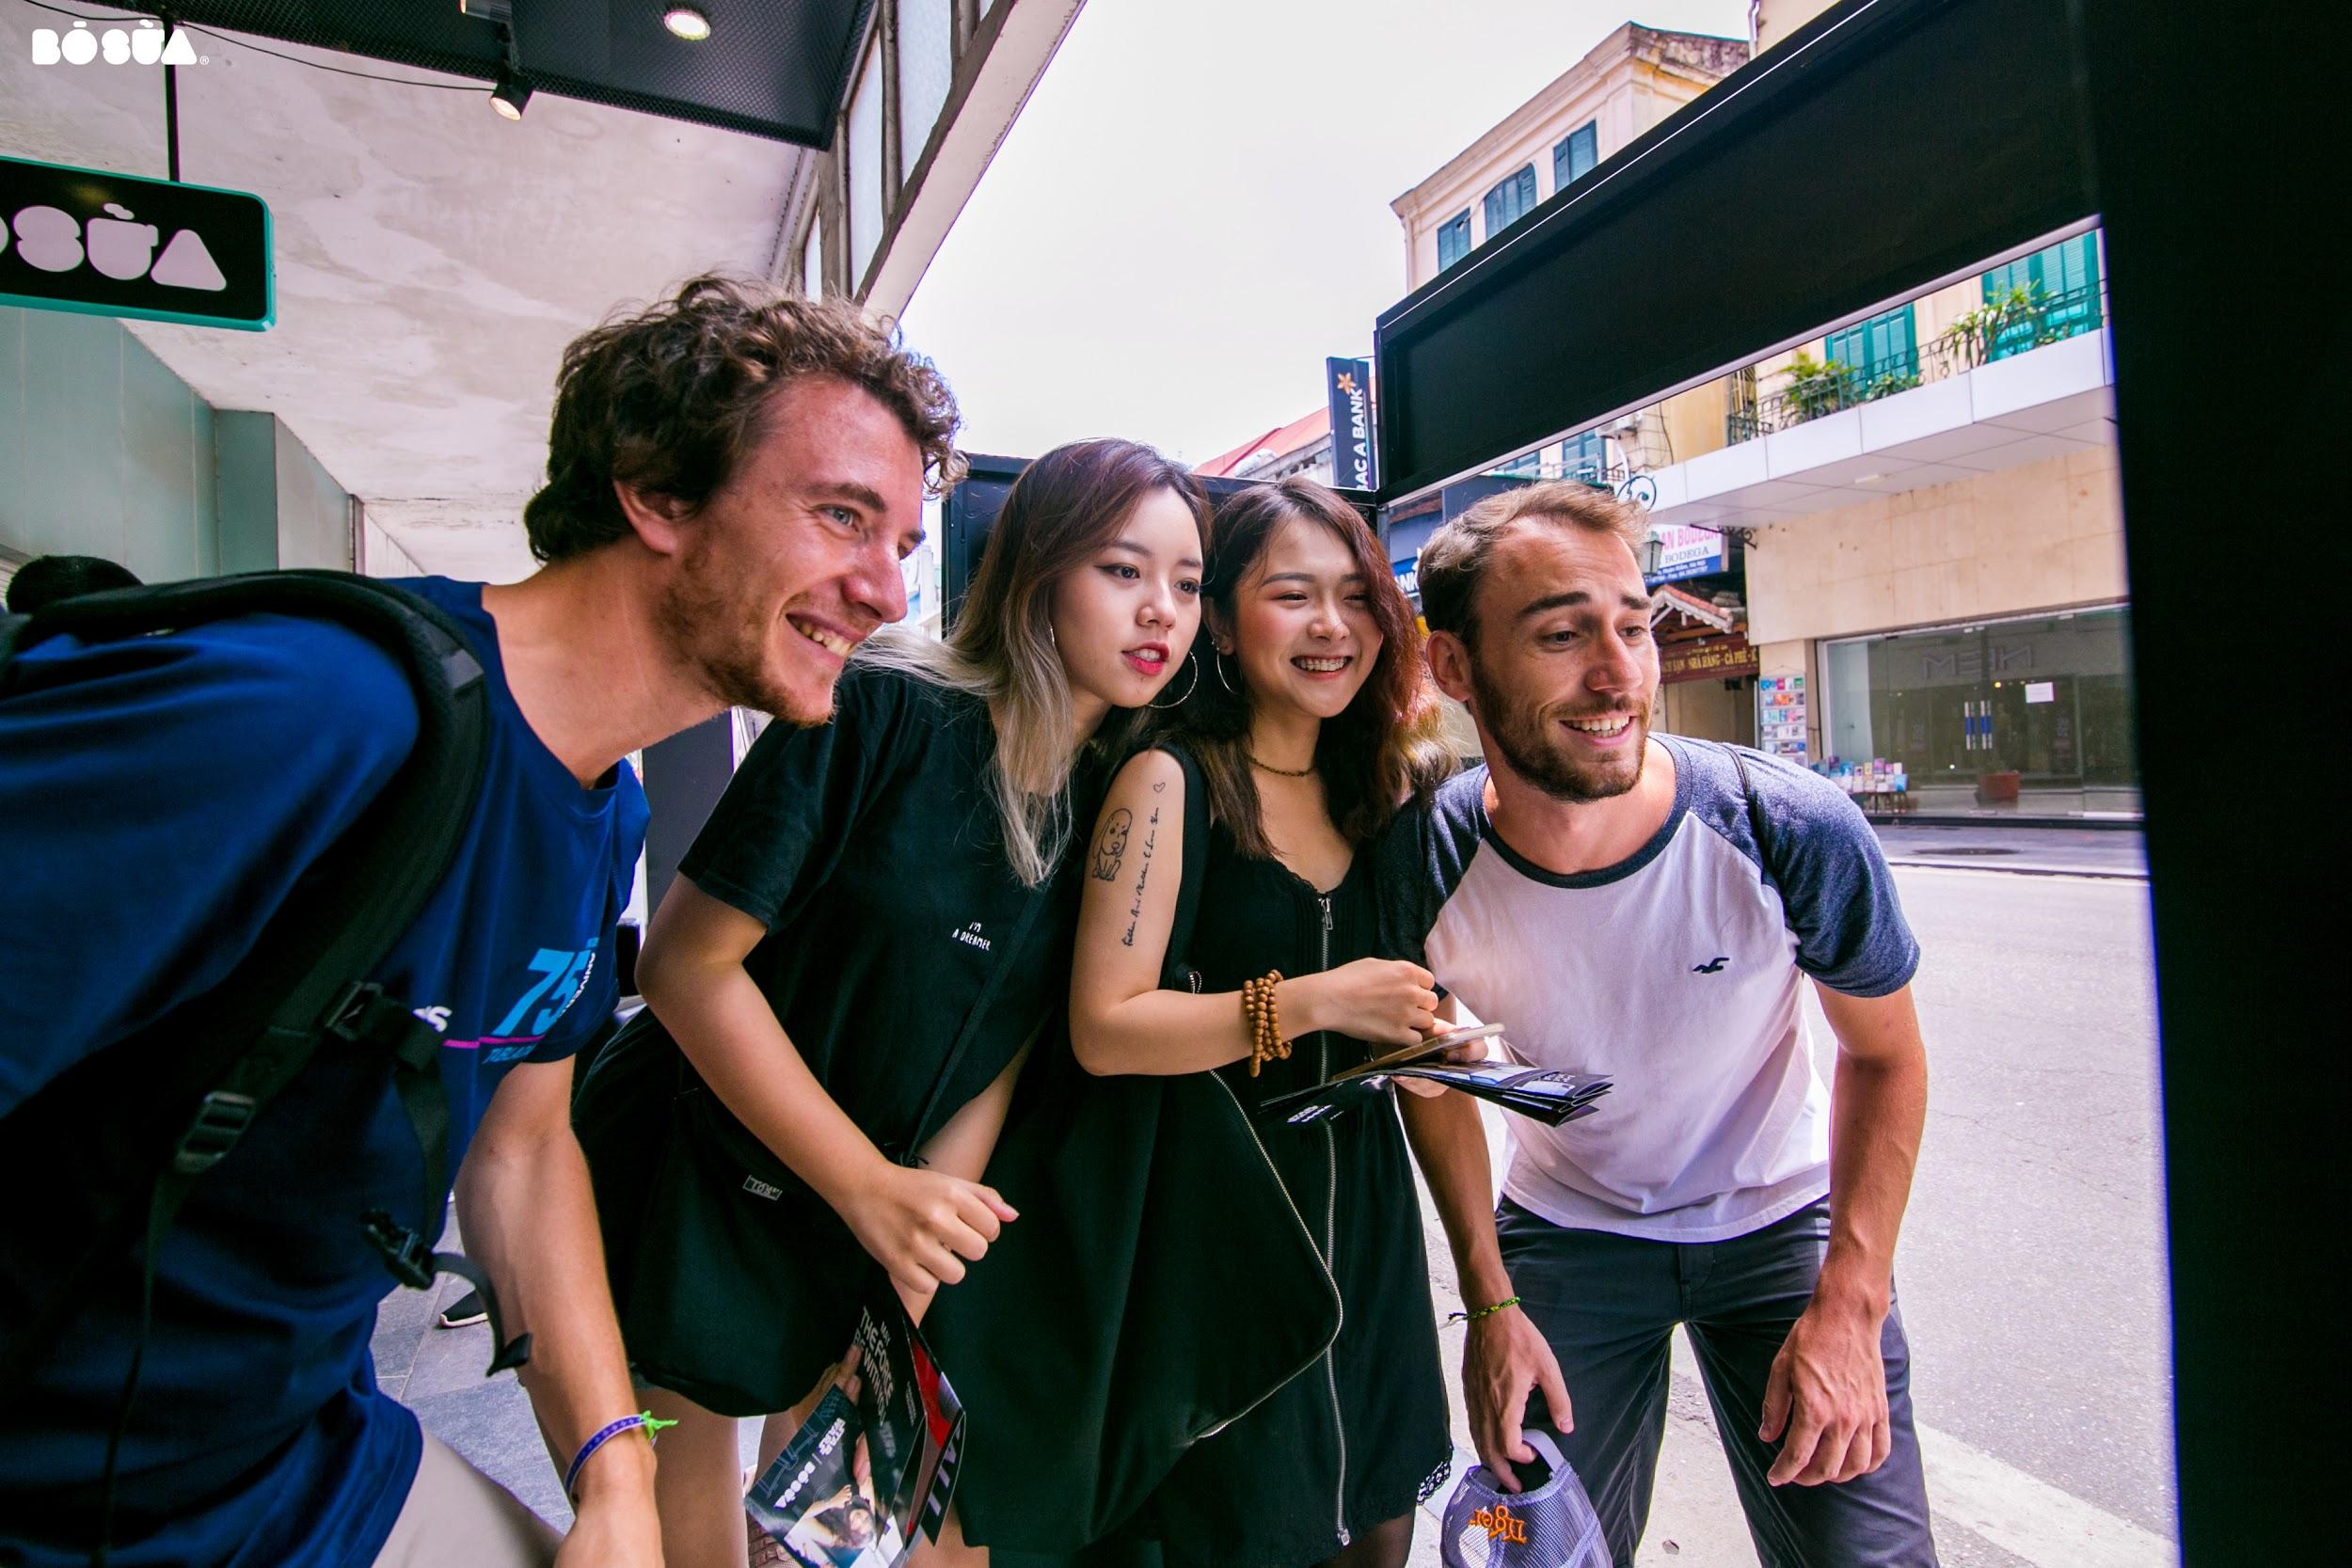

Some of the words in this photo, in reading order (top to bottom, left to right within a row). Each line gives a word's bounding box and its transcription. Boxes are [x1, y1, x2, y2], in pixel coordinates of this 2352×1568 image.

[1349, 388, 1366, 439] BANK
[1353, 442, 1367, 456] A
[1664, 546, 1709, 563] BODEGA
[960, 931, 991, 951] DREAMER
[860, 1306, 879, 1345] THE
[875, 1339, 895, 1406] FORCE
[864, 1348, 880, 1394] WITH
